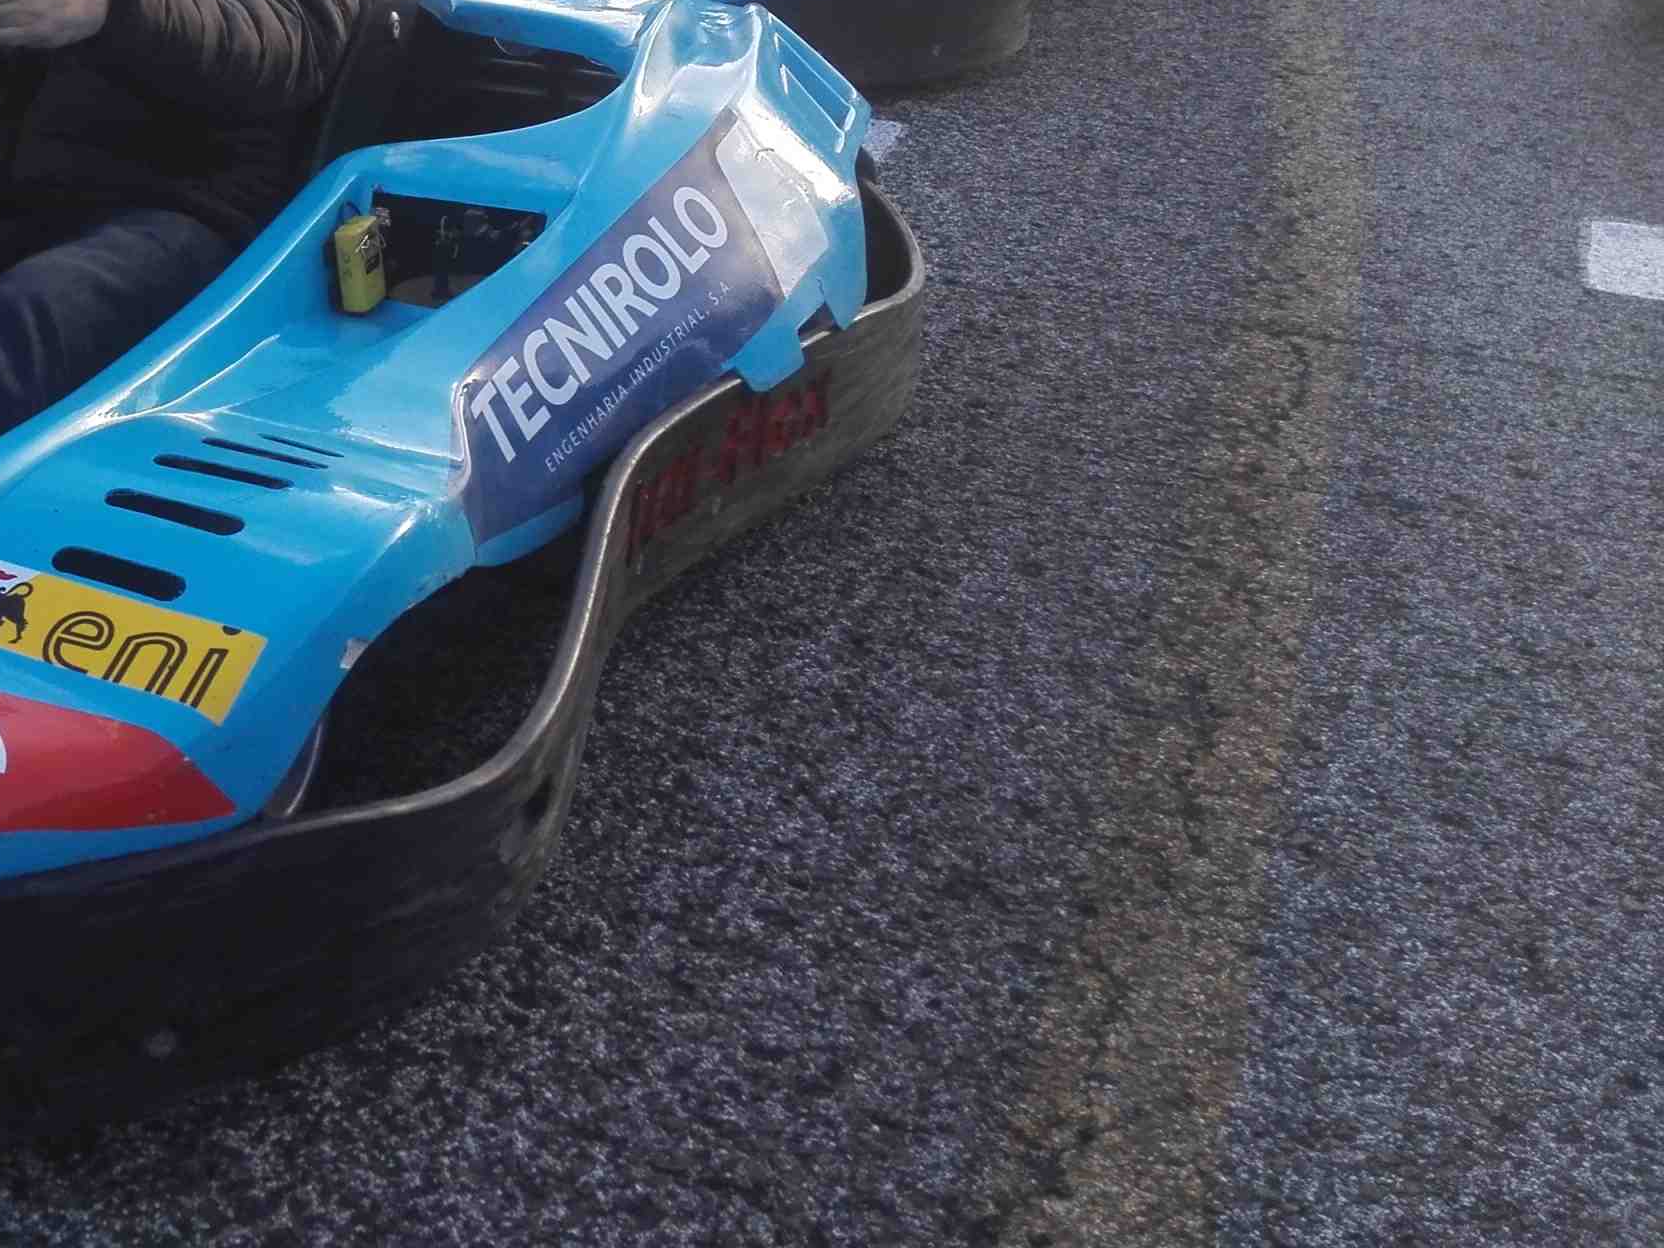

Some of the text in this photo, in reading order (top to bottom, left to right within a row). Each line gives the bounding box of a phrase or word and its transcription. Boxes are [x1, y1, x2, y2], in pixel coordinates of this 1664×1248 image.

[471, 186, 728, 464] TECNIROLO
[544, 383, 630, 473] ENGENHARIA
[42, 610, 242, 710] eni
